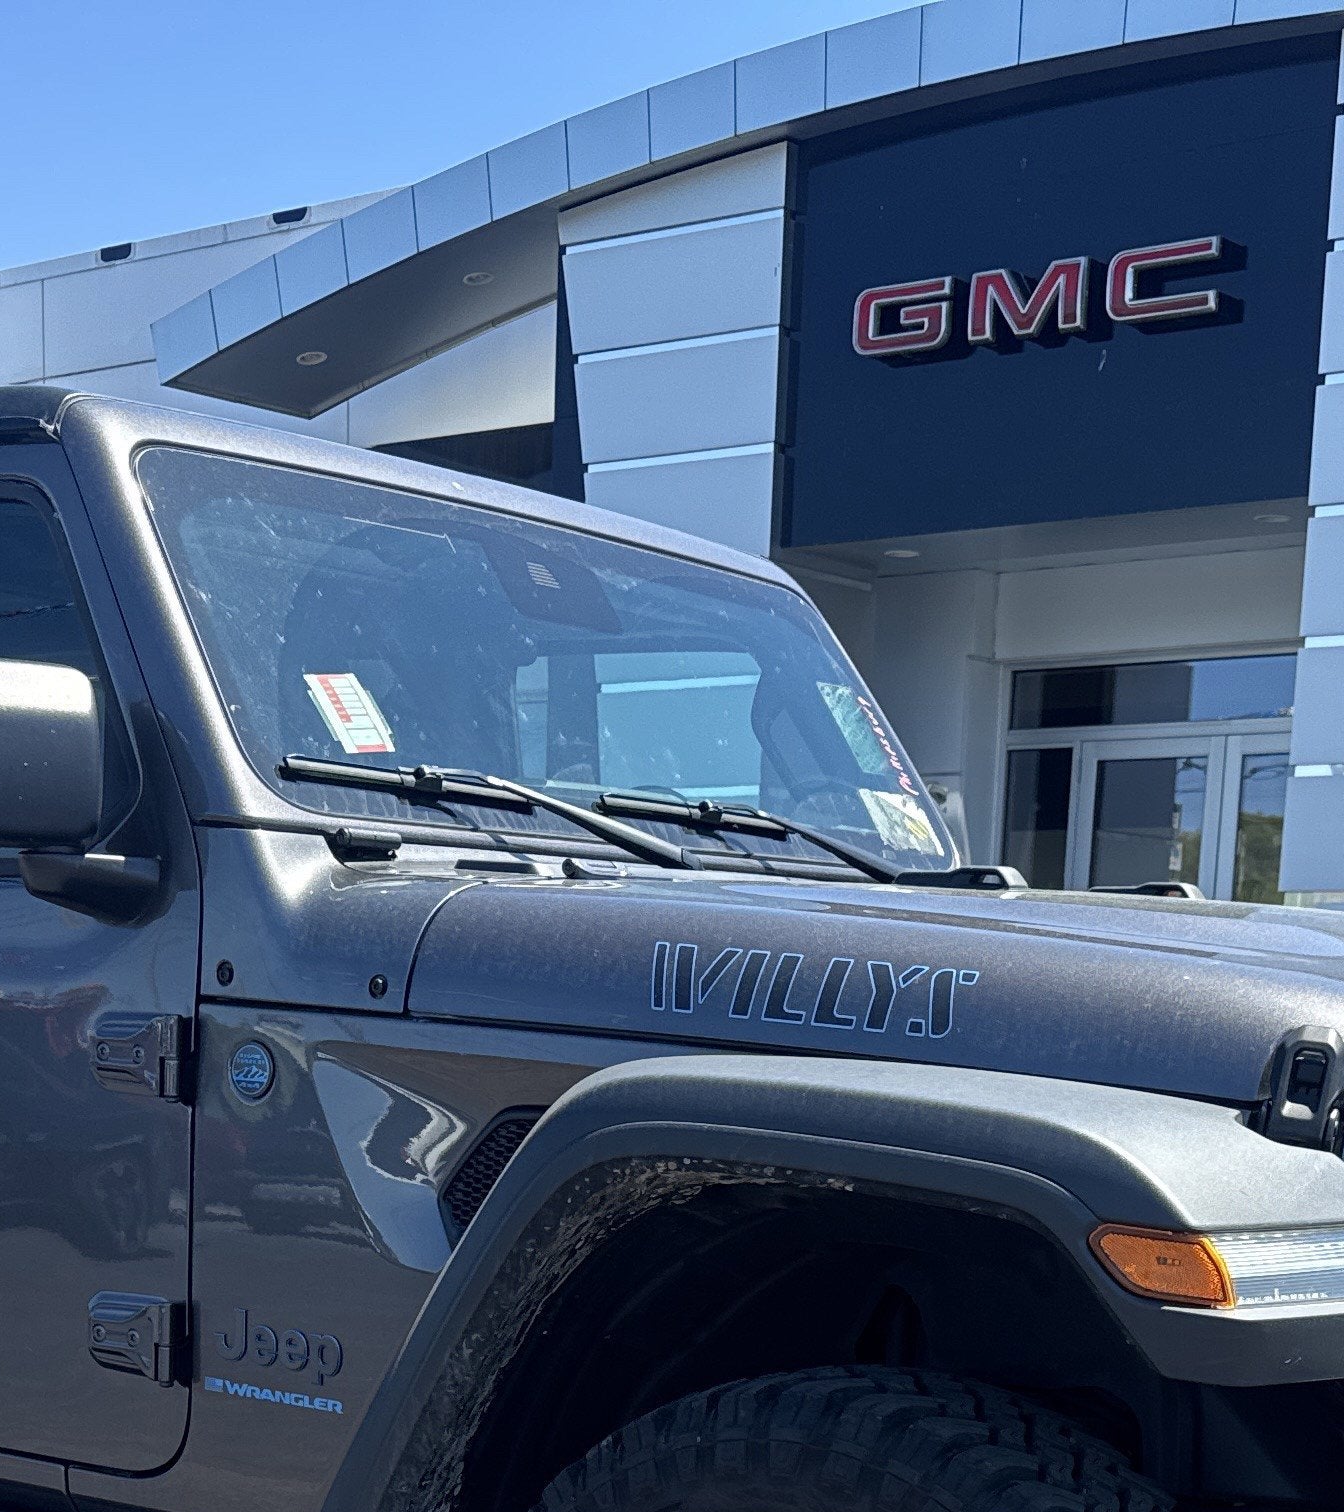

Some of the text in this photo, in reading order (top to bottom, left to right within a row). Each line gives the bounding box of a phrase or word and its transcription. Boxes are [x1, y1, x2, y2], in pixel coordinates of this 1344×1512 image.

[852, 235, 1223, 356] GMC
[651, 941, 980, 1039] WILLYS
[213, 1307, 344, 1386] Jeep
[223, 1380, 344, 1415] WRANGLER
